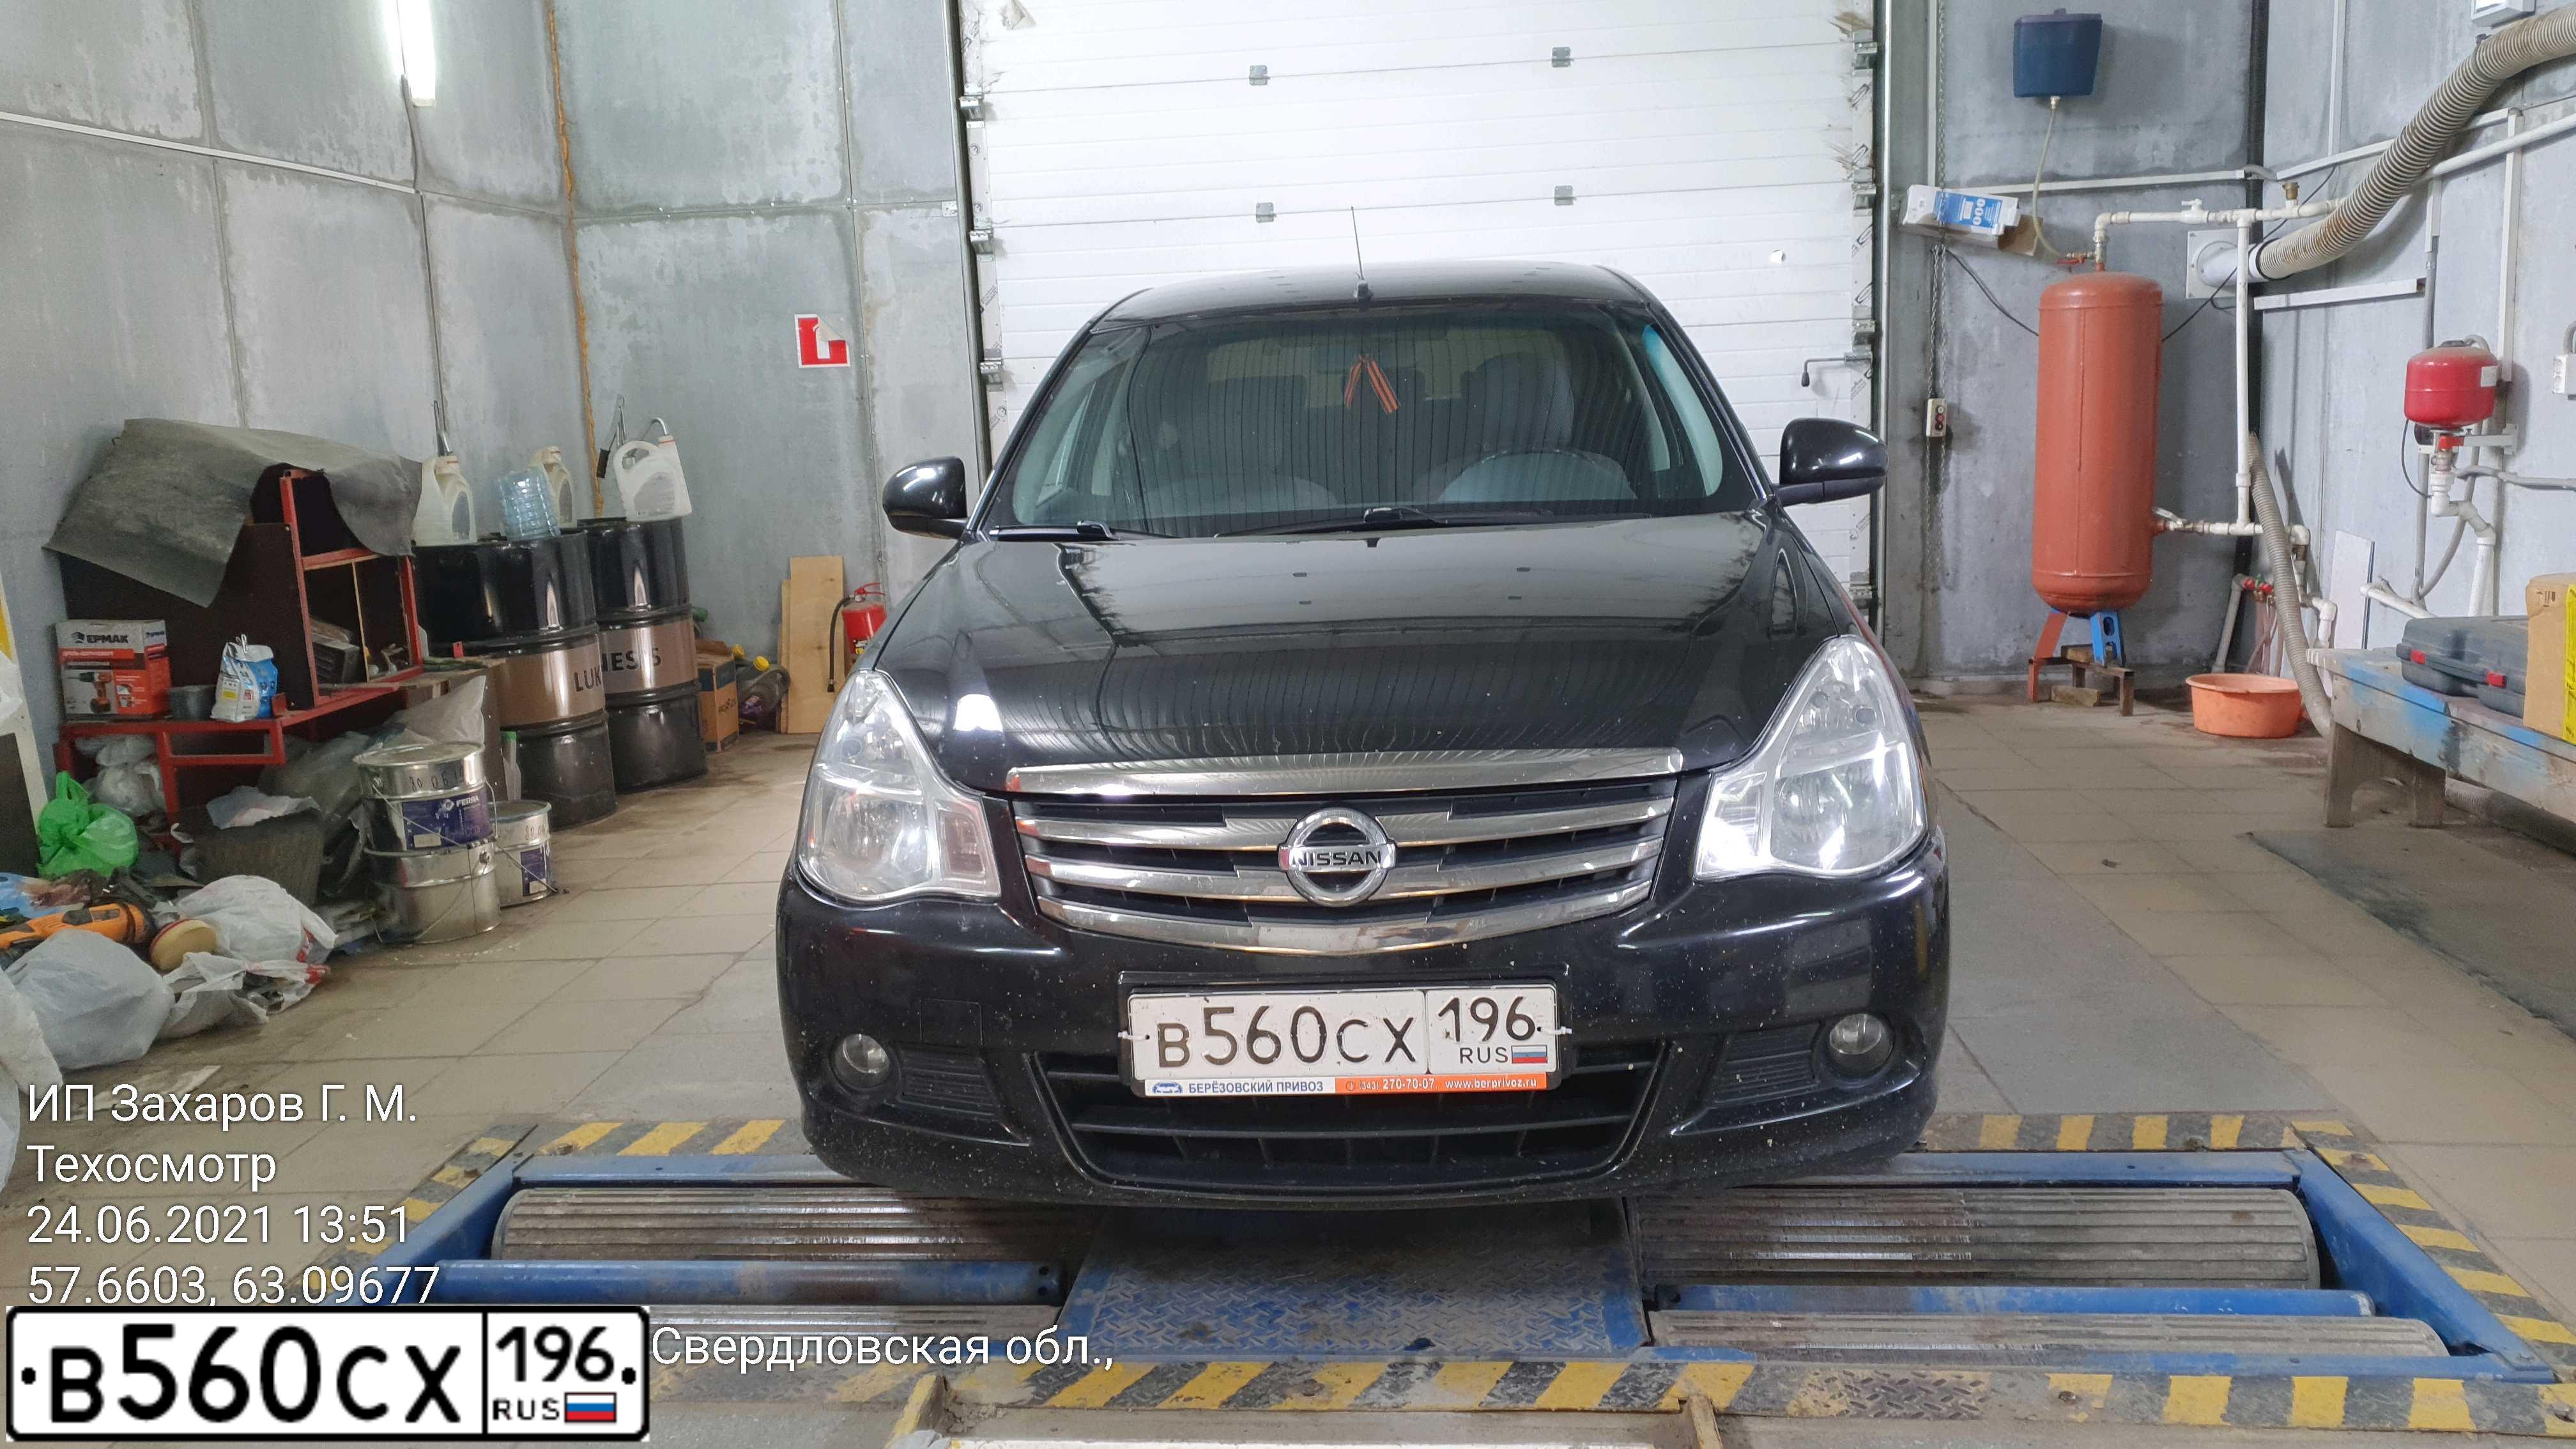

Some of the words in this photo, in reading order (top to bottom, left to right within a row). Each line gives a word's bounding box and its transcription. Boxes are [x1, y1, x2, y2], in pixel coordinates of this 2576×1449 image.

[1291, 850, 1382, 867] NISSAN
[1156, 1004, 1417, 1069] В560СХ
[1438, 995, 1536, 1043] 196
[1459, 1046, 1509, 1065] RUS
[1188, 1079, 1273, 1094] БЕРЁЗОВСКИЙ
[1276, 1080, 1324, 1092] ПРИВОЗ
[1445, 1077, 1538, 1089] www.berprivoz.ru
